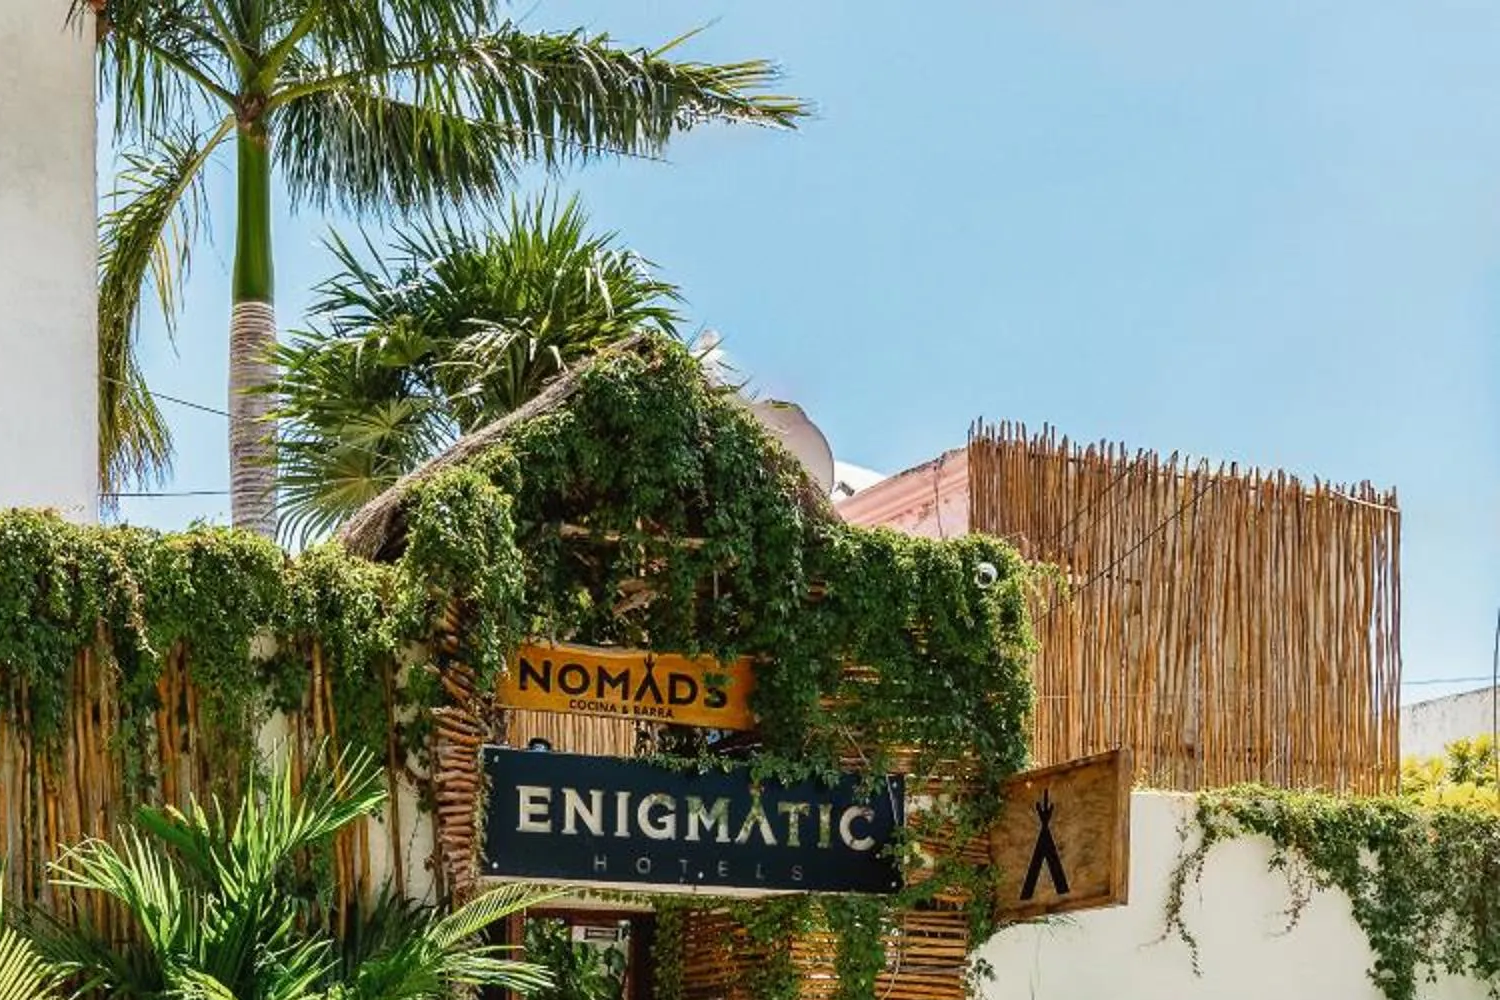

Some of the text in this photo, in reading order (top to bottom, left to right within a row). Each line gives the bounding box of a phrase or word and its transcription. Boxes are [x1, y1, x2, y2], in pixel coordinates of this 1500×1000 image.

[569, 699, 675, 719] COCINA & BARRA
[515, 782, 876, 851] ENIGMATIC
[593, 854, 804, 882] HOTELS
